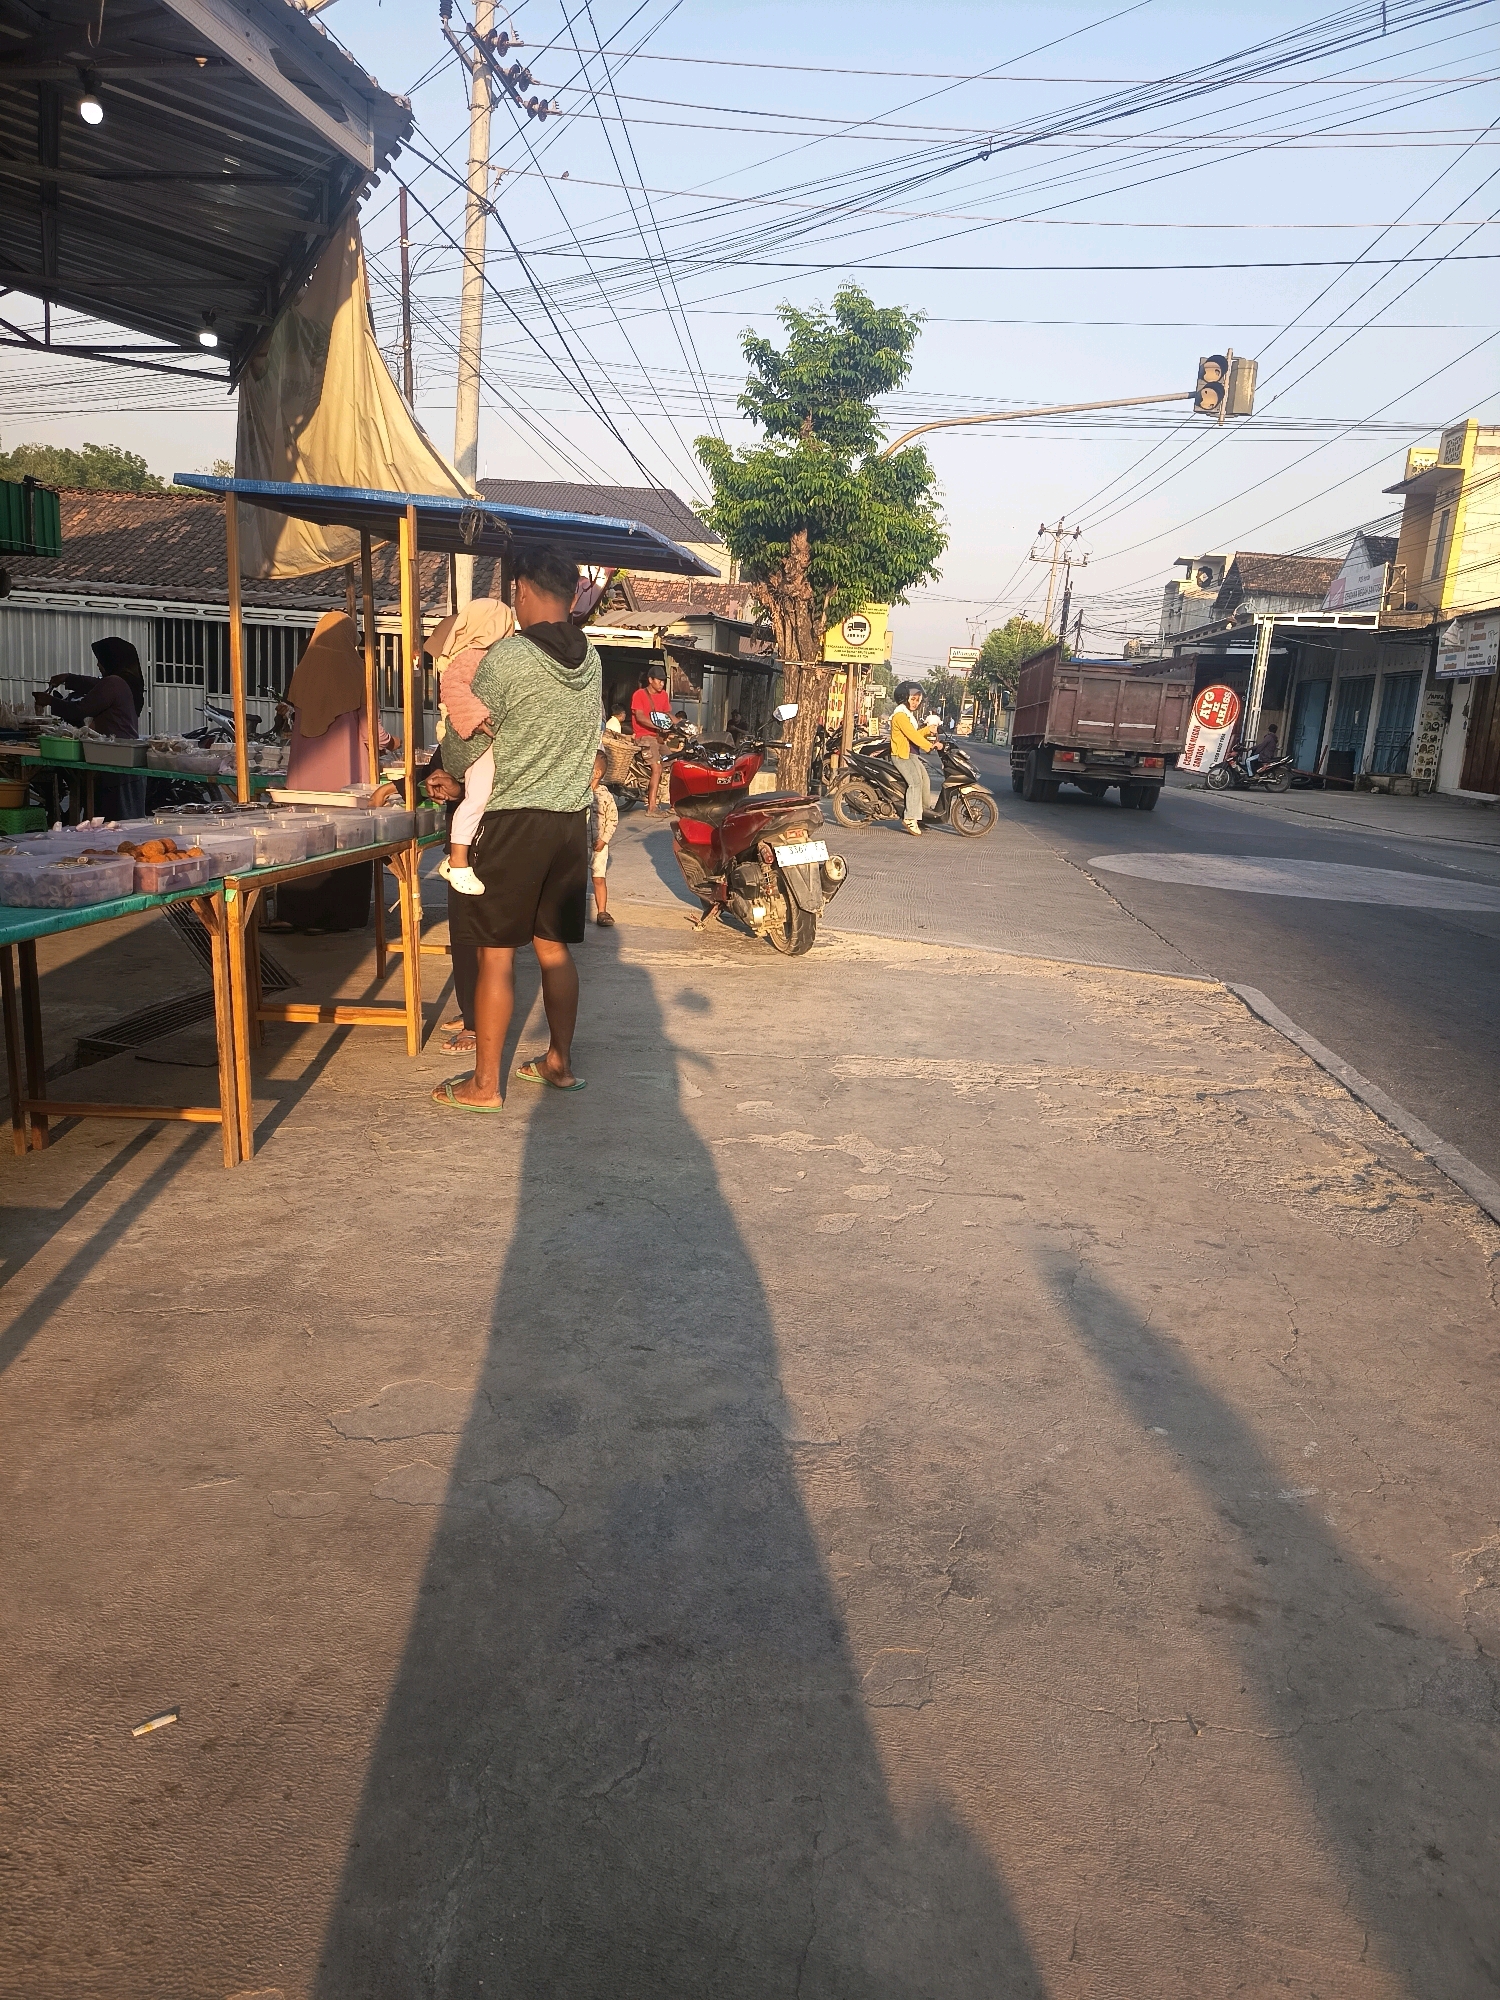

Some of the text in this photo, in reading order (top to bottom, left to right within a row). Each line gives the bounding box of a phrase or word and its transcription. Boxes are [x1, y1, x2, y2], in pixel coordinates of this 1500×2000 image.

[1199, 691, 1215, 720] AYO
[1216, 691, 1232, 725] AHASS
[1193, 745, 1206, 768] SANTOSA
